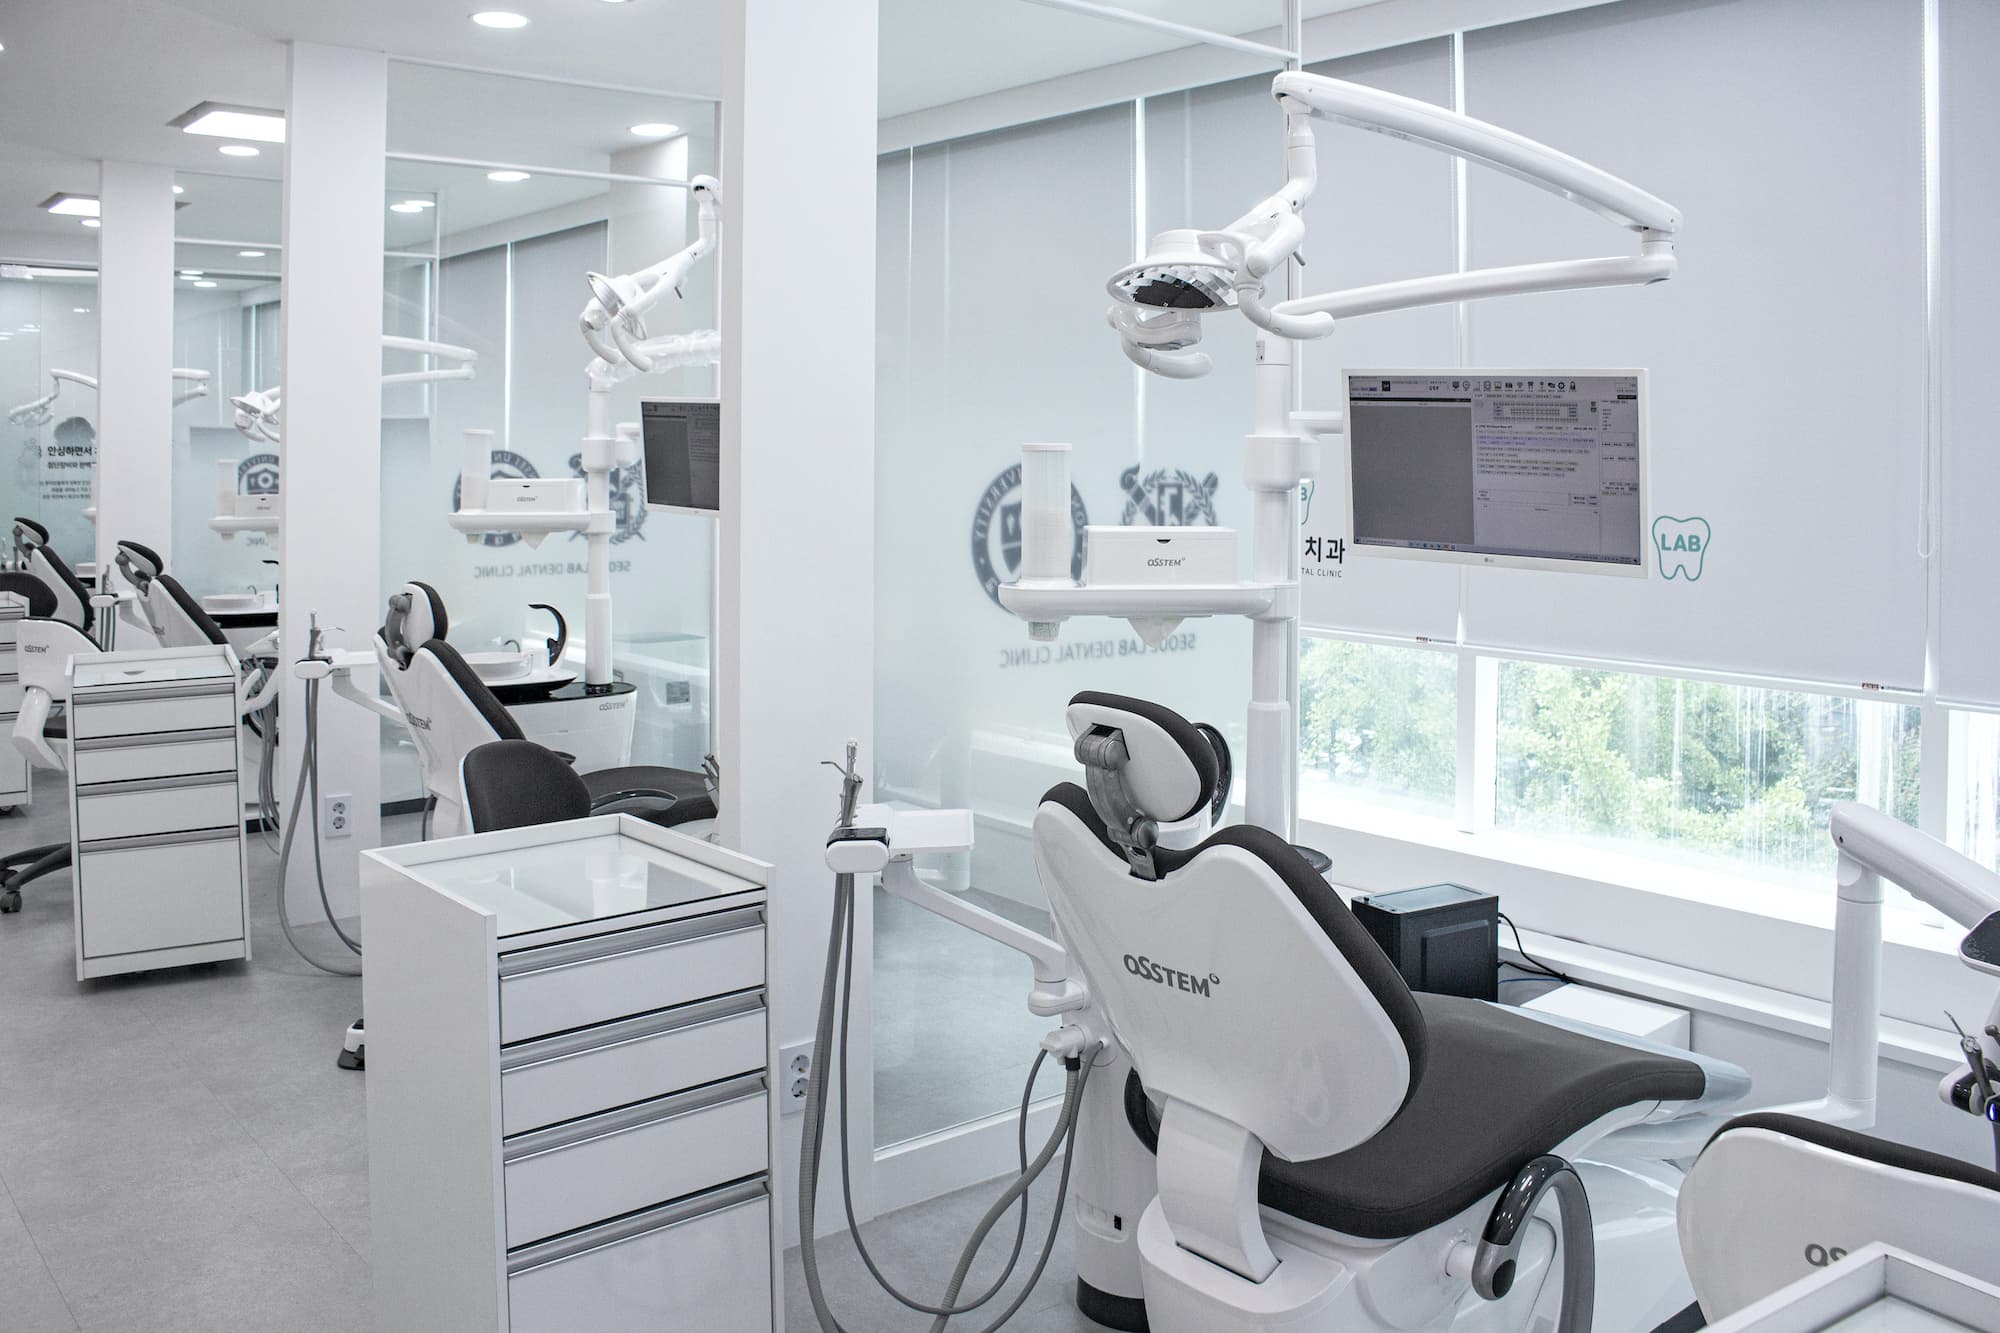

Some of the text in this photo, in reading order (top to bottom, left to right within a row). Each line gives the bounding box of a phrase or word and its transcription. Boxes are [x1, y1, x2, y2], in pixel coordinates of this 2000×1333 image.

[48, 446, 92, 457] 안심하면서
[1305, 536, 1346, 564] 치과
[1661, 533, 1701, 552] LAB
[1301, 567, 1343, 578] TAL CLINIC
[1123, 954, 1211, 998] OSSTEM
